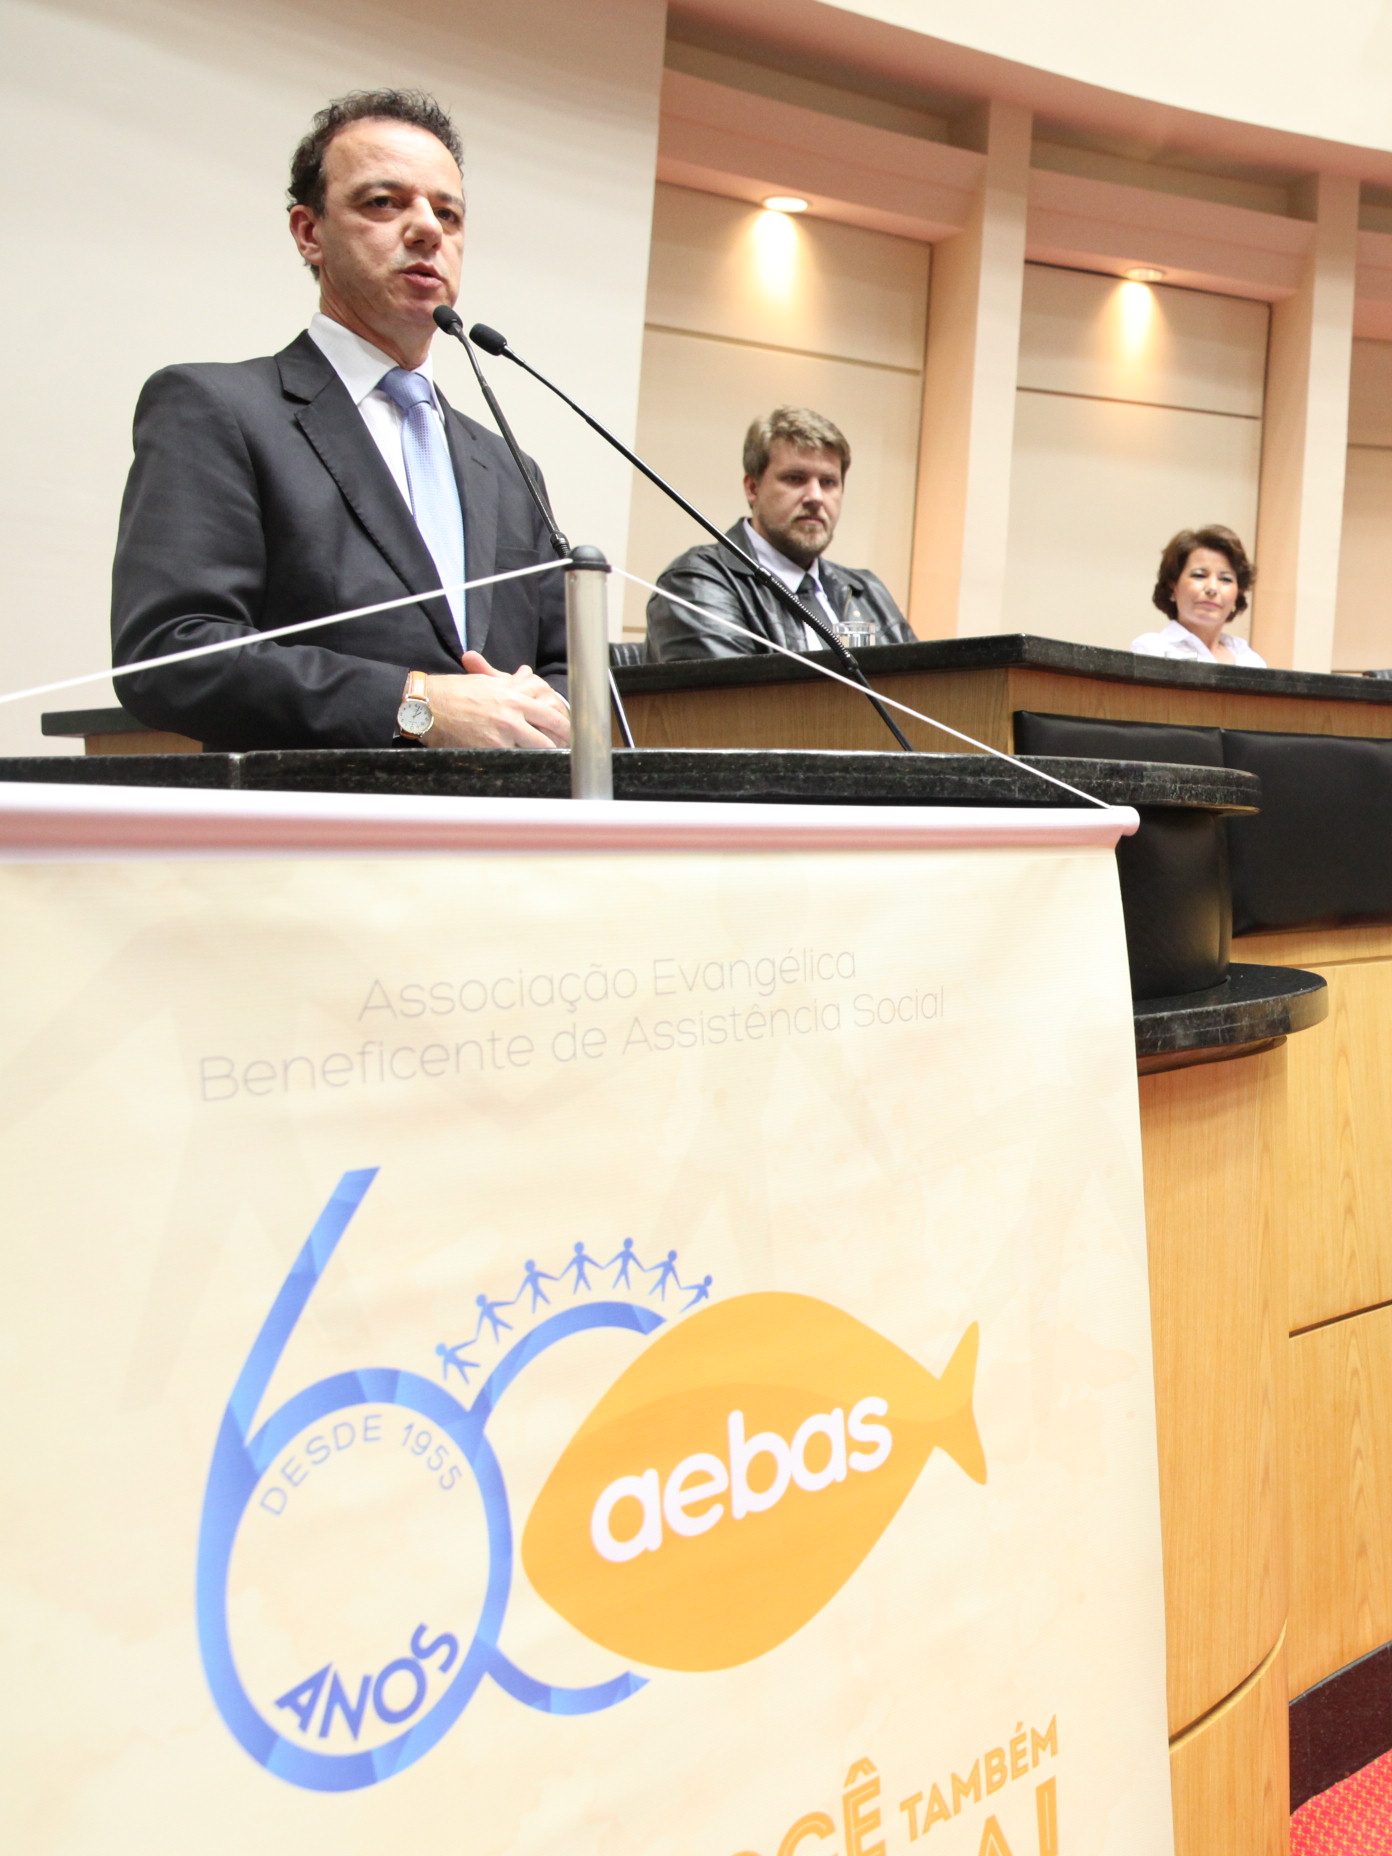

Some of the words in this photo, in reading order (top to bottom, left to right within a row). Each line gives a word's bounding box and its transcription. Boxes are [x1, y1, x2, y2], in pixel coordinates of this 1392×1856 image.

[199, 1029, 535, 1103] Beneficente
[551, 1022, 608, 1064] de
[621, 997, 842, 1056] Assistência
[852, 985, 945, 1029] Social
[357, 963, 638, 1022] Associação
[652, 947, 857, 997] Evangélica
[259, 1414, 383, 1516] DESDE
[401, 1422, 463, 1492] 1955
[590, 1396, 894, 1563] aebas
[273, 1622, 460, 1742] ANOS
[899, 1714, 1059, 1843] TAMBÉM
